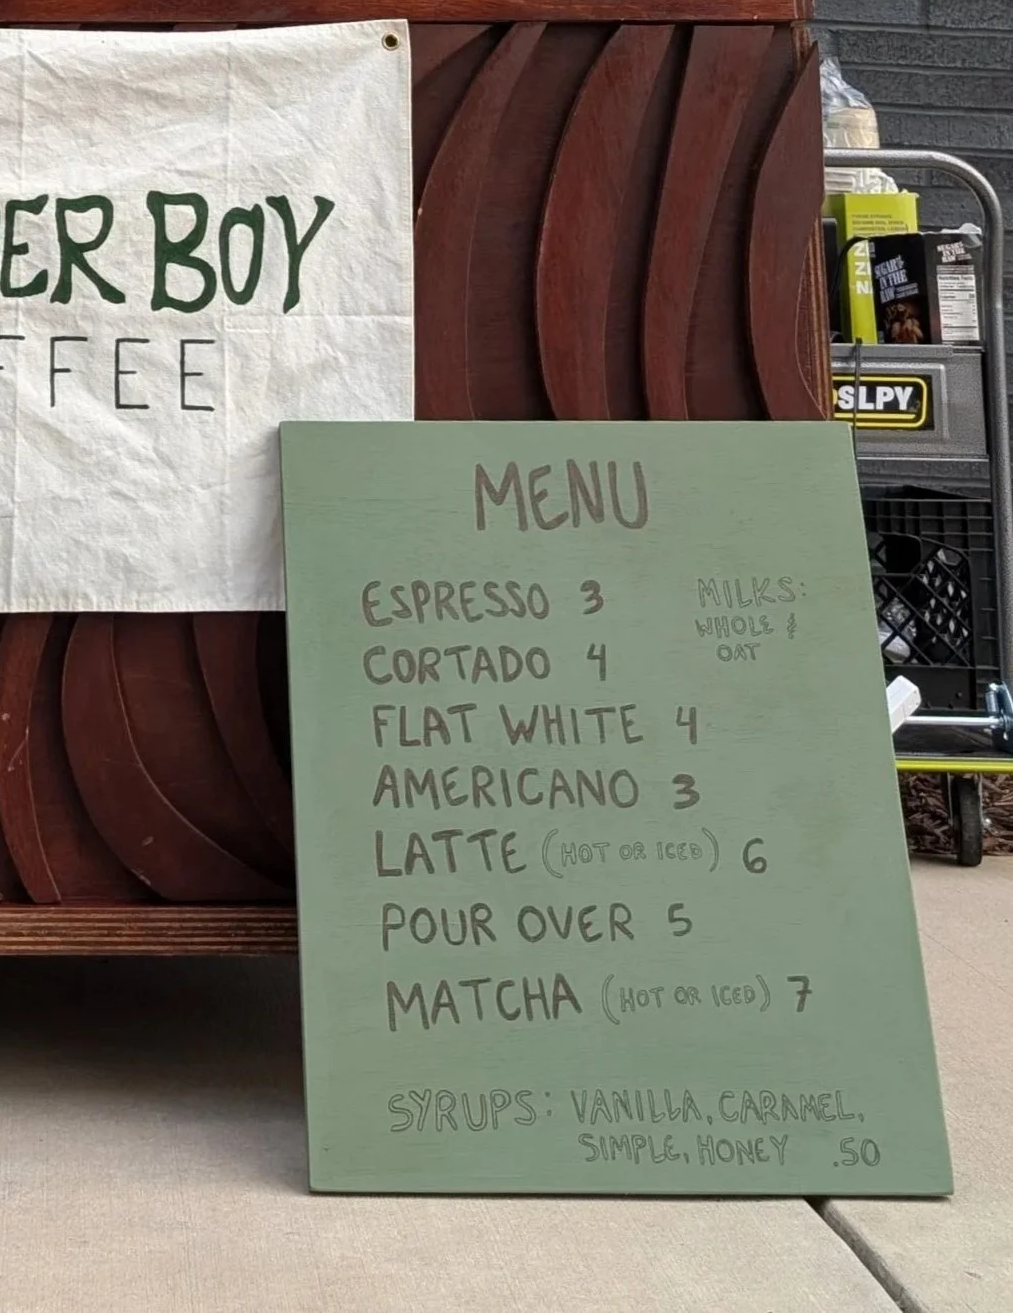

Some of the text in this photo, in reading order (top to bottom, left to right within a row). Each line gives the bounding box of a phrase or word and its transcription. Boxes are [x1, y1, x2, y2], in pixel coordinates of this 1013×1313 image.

[145, 189, 336, 315] BOY
[474, 458, 649, 533] MENU
[361, 579, 605, 628] ESPRESSO 3
[697, 576, 807, 609] MILKS:
[694, 614, 775, 639] WHOLE
[362, 643, 607, 686] CORTADO 4
[716, 642, 761, 663] OAT
[372, 702, 698, 748] FLAT WHITE 4
[372, 764, 701, 811] AMERICANO 3
[375, 826, 768, 880] LATTE (HOT OR ICED) 6
[381, 902, 693, 952] POUR OVER 5
[386, 972, 813, 1033] MATCHA (HOT OR ICED) 7
[387, 1088, 865, 1134] SYRUPS: VANILLA, CARAMEL,
[577, 1132, 882, 1168] SIMPLE, HONEY .50
